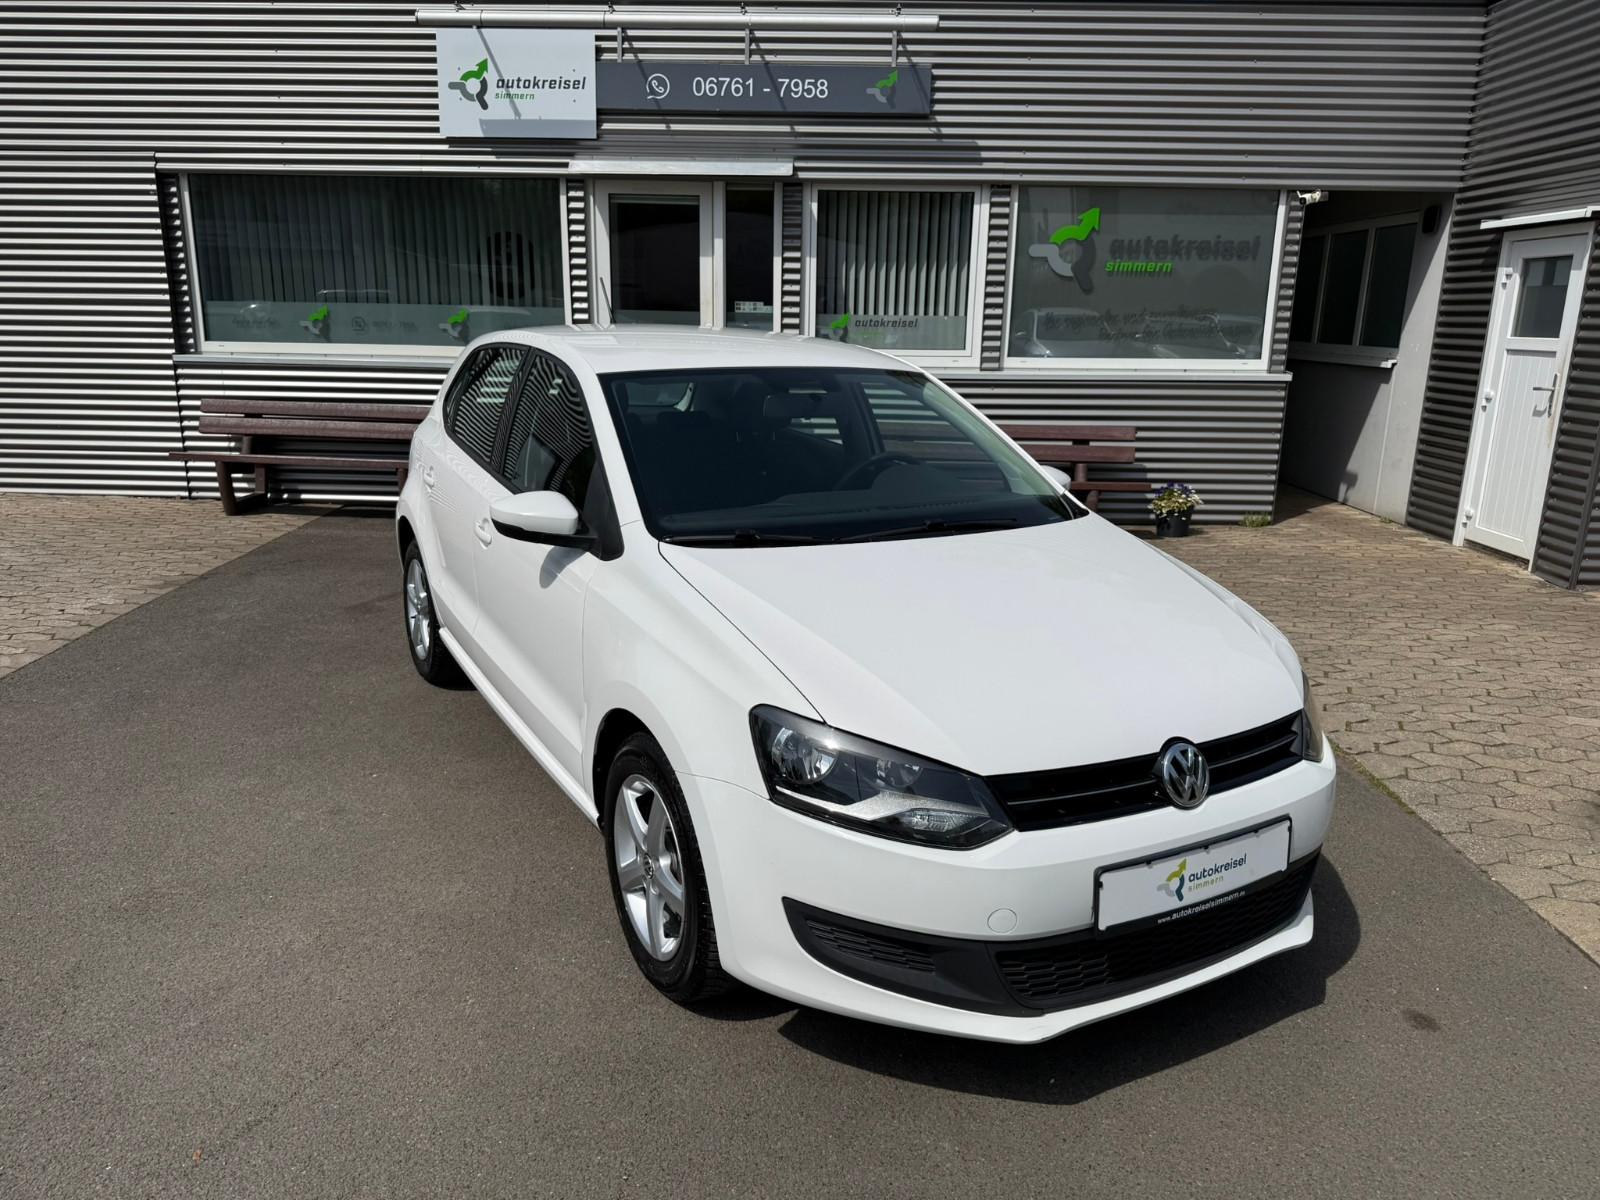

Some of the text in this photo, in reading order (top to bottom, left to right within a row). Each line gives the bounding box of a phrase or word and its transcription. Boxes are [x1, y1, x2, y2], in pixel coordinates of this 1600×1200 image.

[496, 76, 587, 90] autokreisel
[692, 77, 754, 97] 06761
[777, 78, 829, 98] 7958
[495, 91, 535, 100] simmern
[1109, 234, 1262, 261] autokreisel
[1104, 259, 1175, 274] simmern
[855, 318, 919, 328] autokreisel
[1188, 852, 1247, 882] autokreisel
[1188, 876, 1224, 892] simmern
